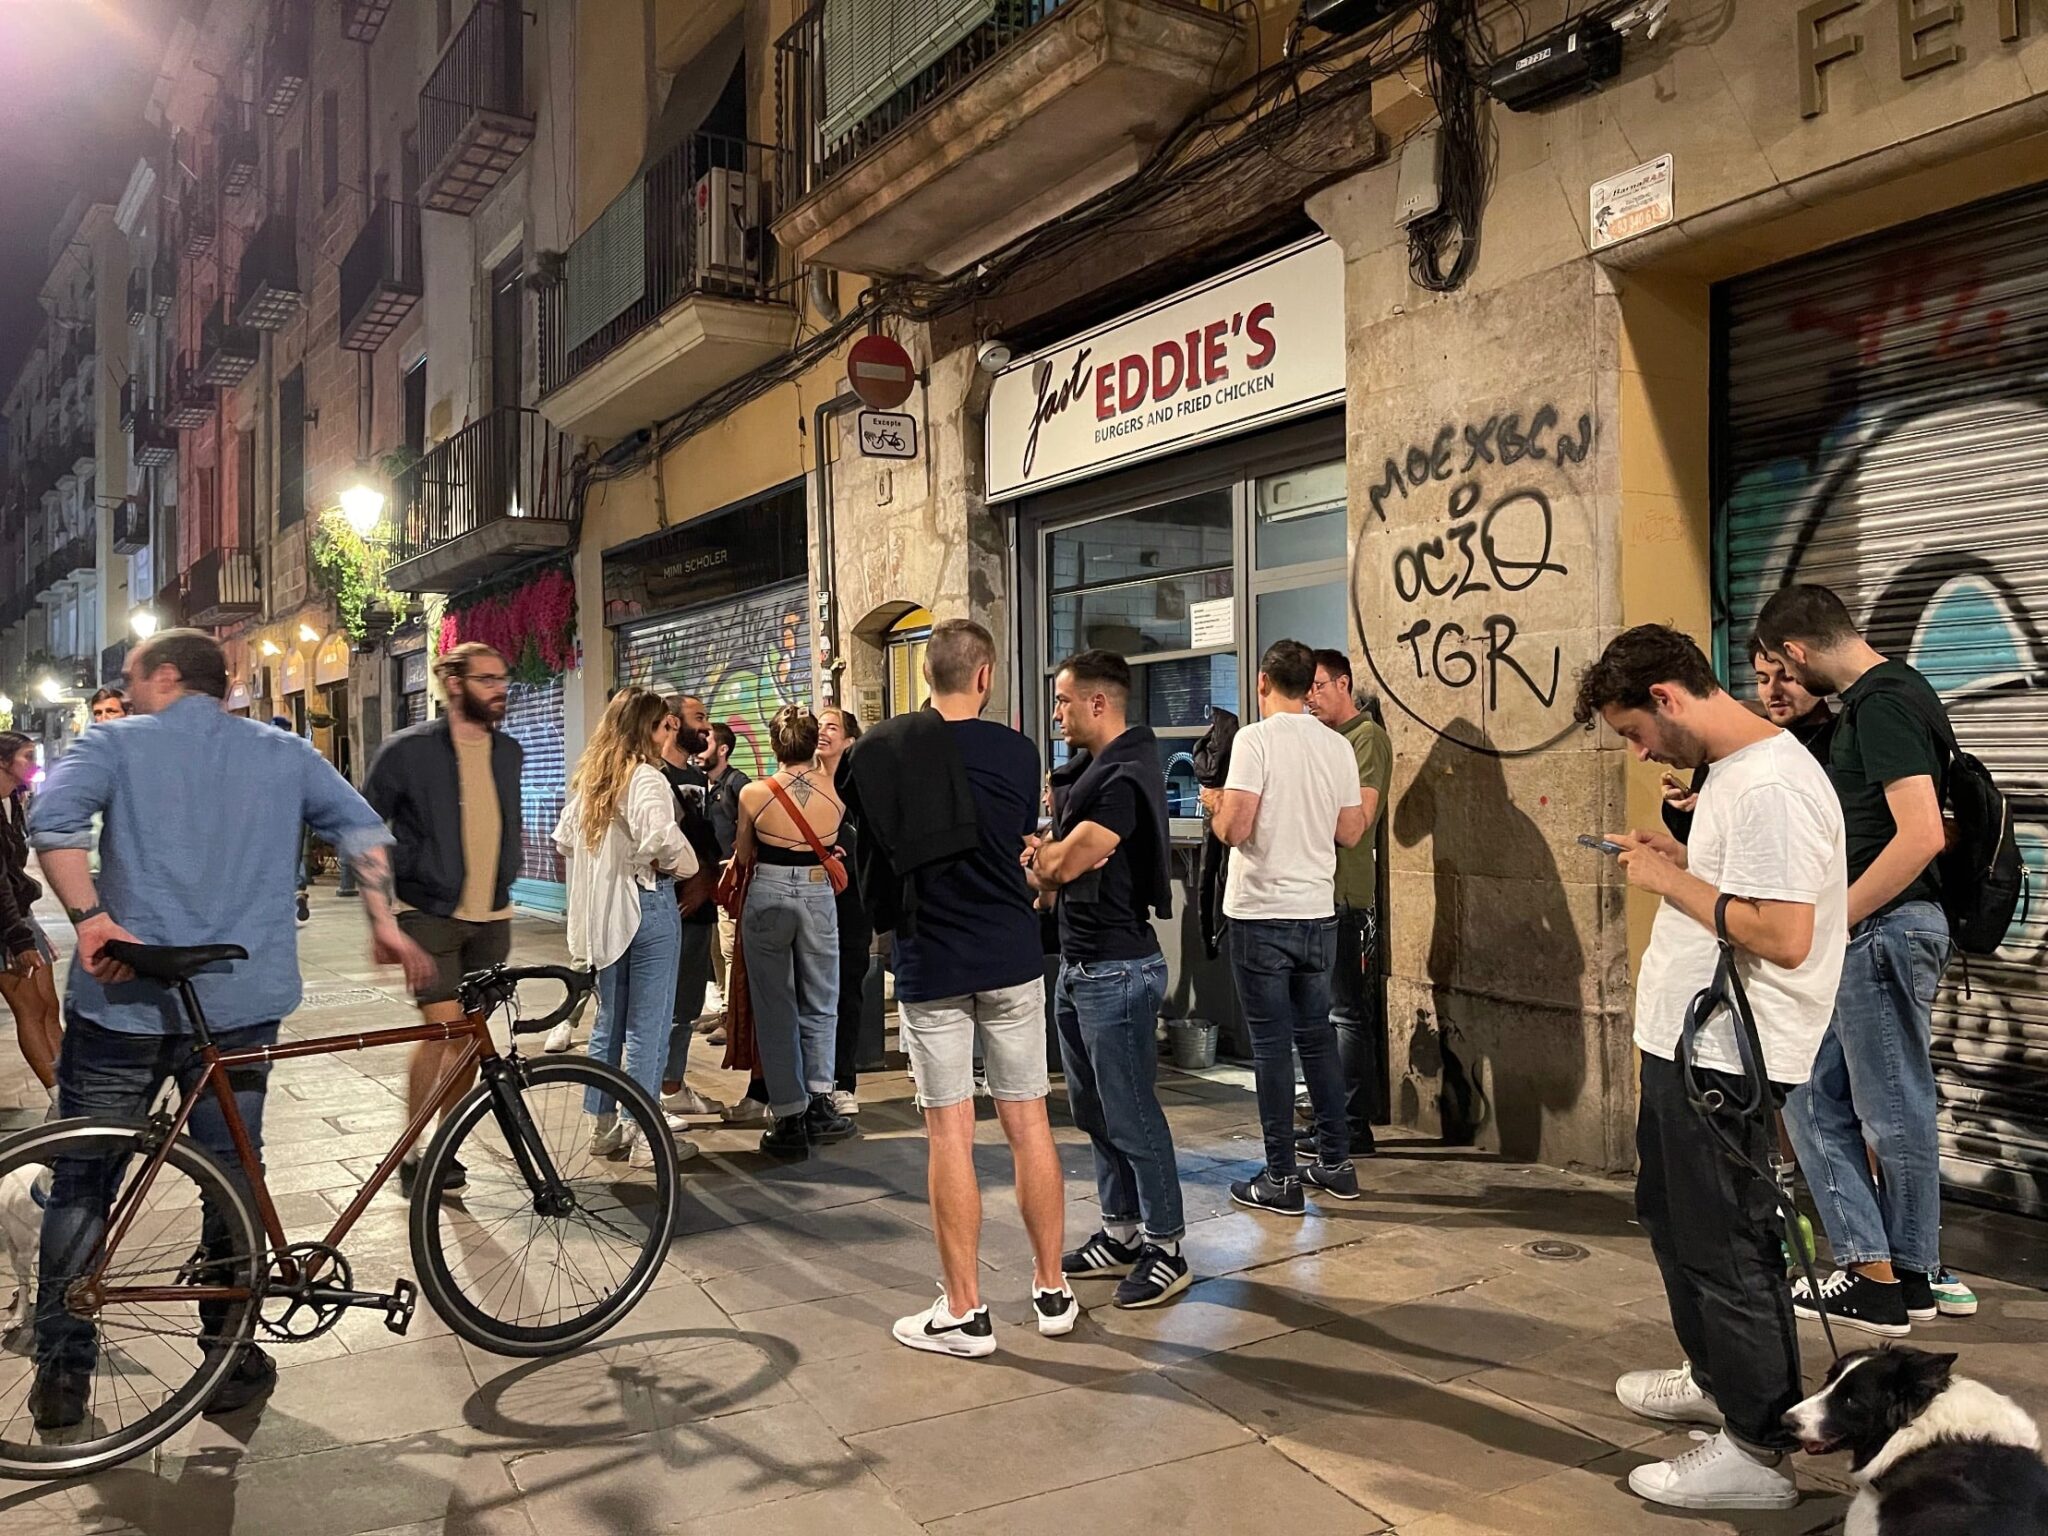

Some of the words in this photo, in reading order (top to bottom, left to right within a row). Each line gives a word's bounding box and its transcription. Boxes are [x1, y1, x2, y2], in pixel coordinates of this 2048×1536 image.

[1096, 302, 1277, 422] EDDIE'S
[1095, 415, 1143, 443] BURGERS
[1147, 406, 1173, 427] AND
[1177, 394, 1211, 417] FRIED
[1215, 372, 1274, 404] CHICKEN
[663, 563, 682, 580] MIMI
[685, 549, 728, 573] SCHOLER
